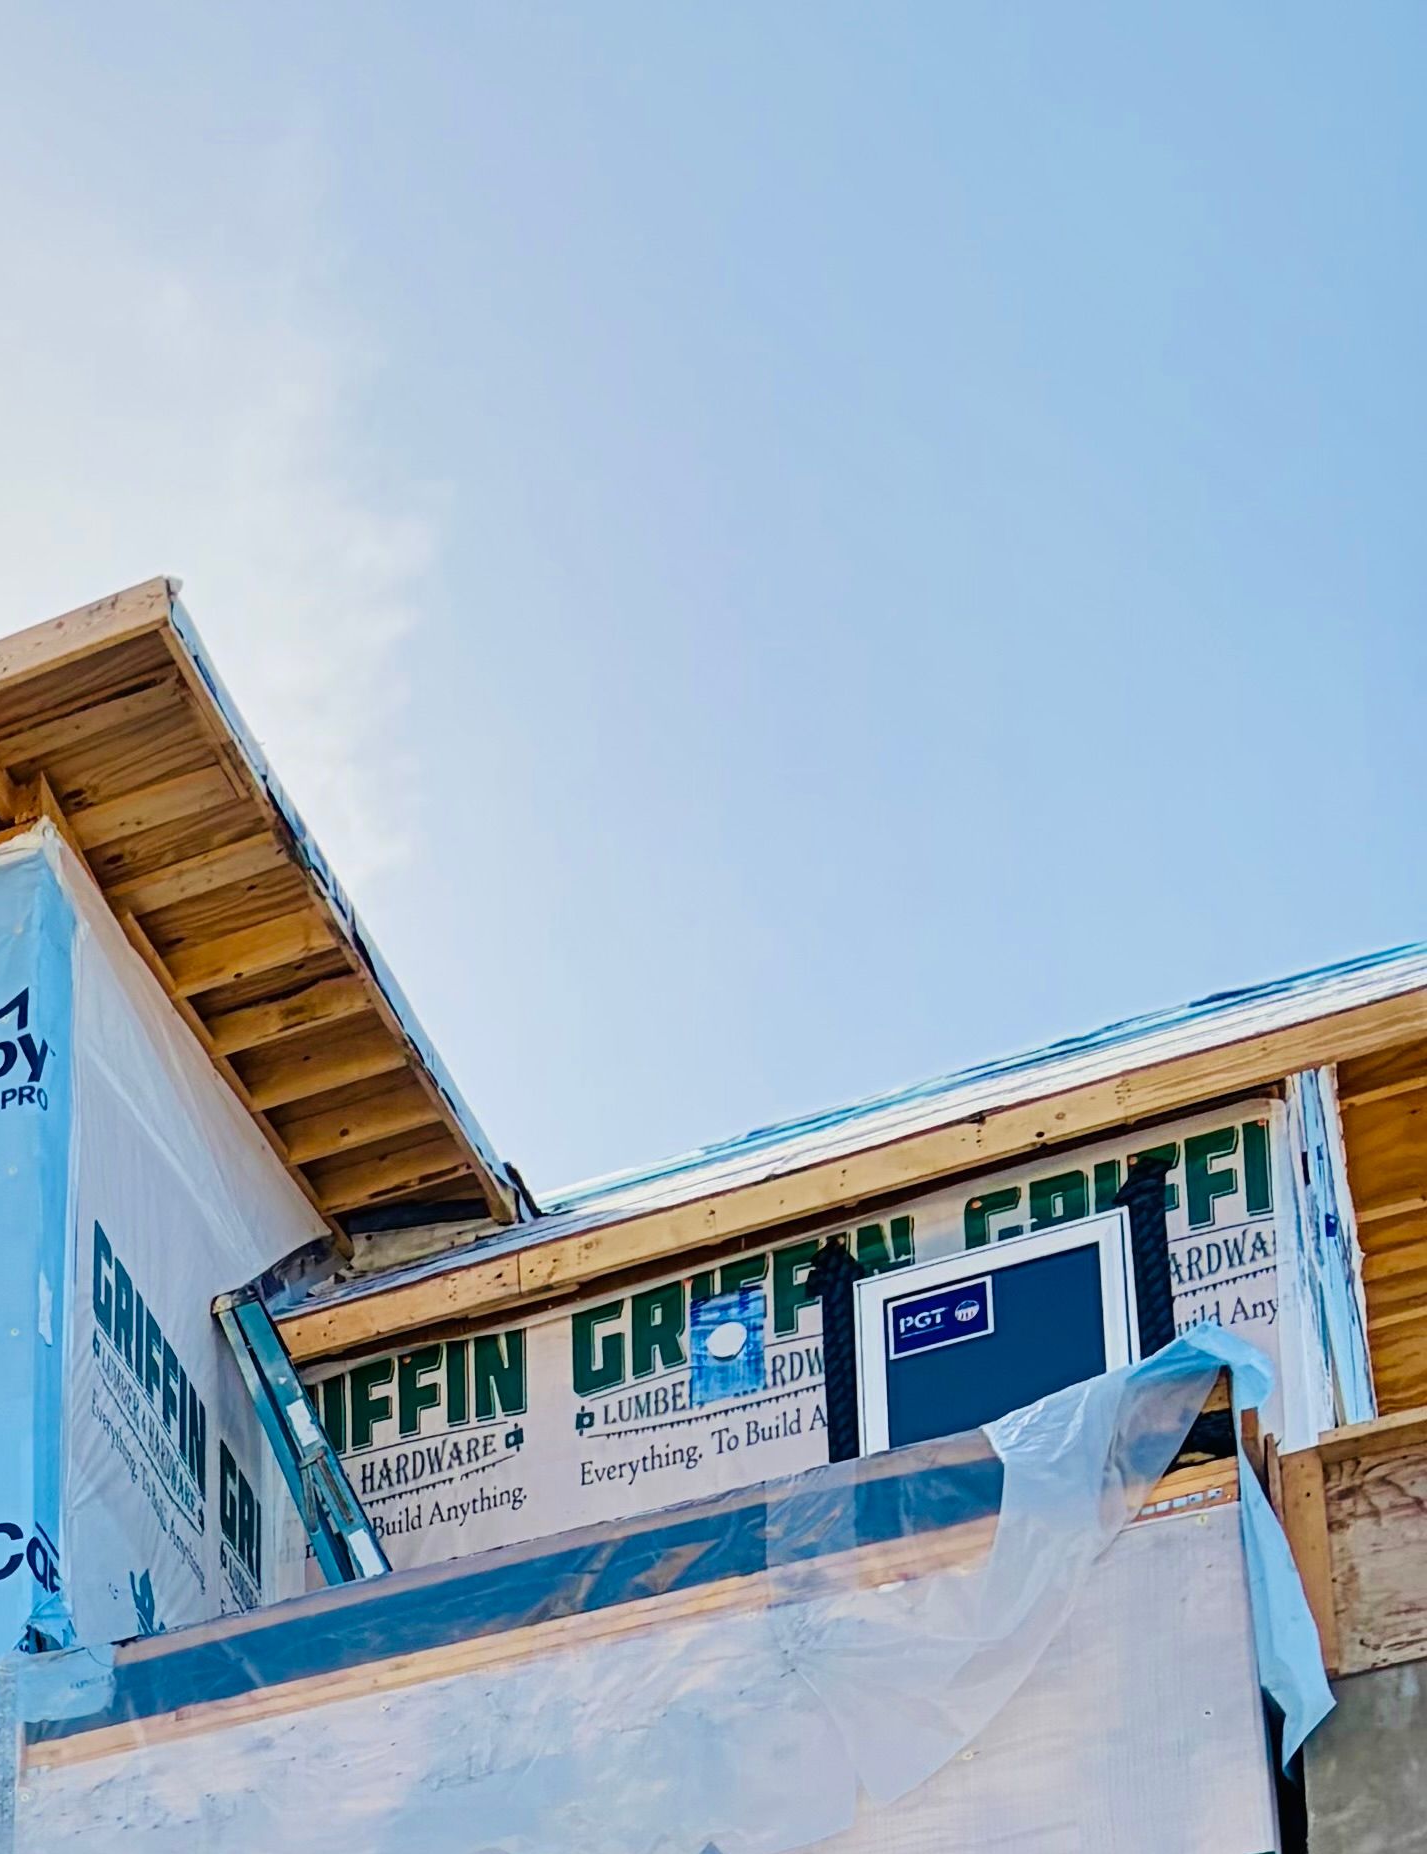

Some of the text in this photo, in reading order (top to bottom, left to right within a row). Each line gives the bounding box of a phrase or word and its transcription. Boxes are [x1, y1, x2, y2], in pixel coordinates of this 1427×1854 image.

[1, 1084, 49, 1111] PRO
[899, 1307, 948, 1334] PGT
[320, 1328, 527, 1454] IFFIN
[361, 1433, 497, 1494] HARDWARE
[580, 1408, 802, 1486] Everything. To Build
[429, 1486, 529, 1526] Anything.
